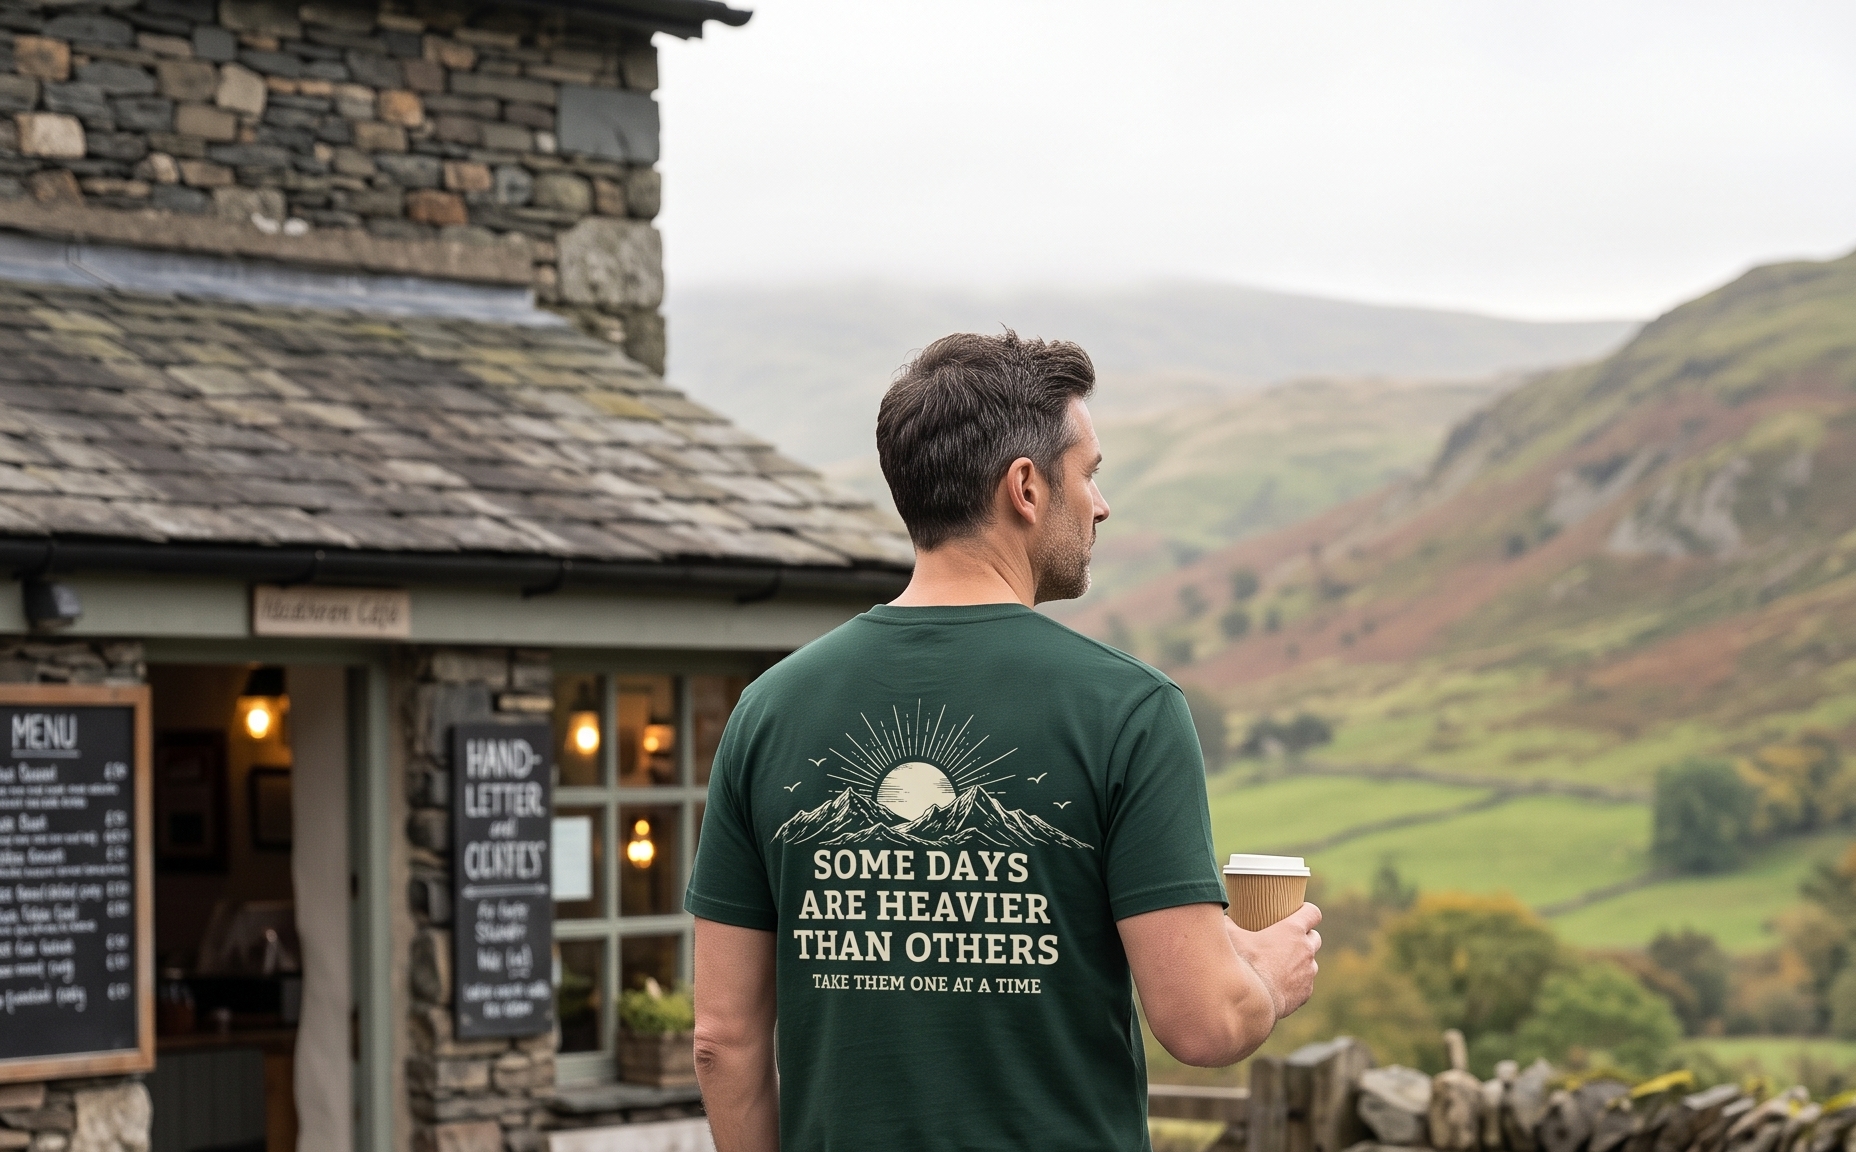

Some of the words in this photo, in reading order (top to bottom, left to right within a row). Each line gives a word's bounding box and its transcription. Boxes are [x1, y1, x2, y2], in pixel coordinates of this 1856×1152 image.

[12, 714, 78, 749] MENU
[466, 739, 542, 779] HAND-
[465, 782, 546, 818] LETTER
[814, 850, 914, 880] SOME
[926, 851, 1029, 882] DAYS
[799, 890, 866, 919] ARE
[877, 891, 1050, 923] HEAVIER
[794, 930, 892, 961] THAN
[906, 932, 1059, 965] OTHERS
[813, 974, 849, 989] TAKE
[854, 975, 905, 990] THEM
[910, 976, 947, 992] ONE
[953, 977, 973, 992] AT
[978, 978, 991, 992] A
[996, 979, 1041, 993] TIME
